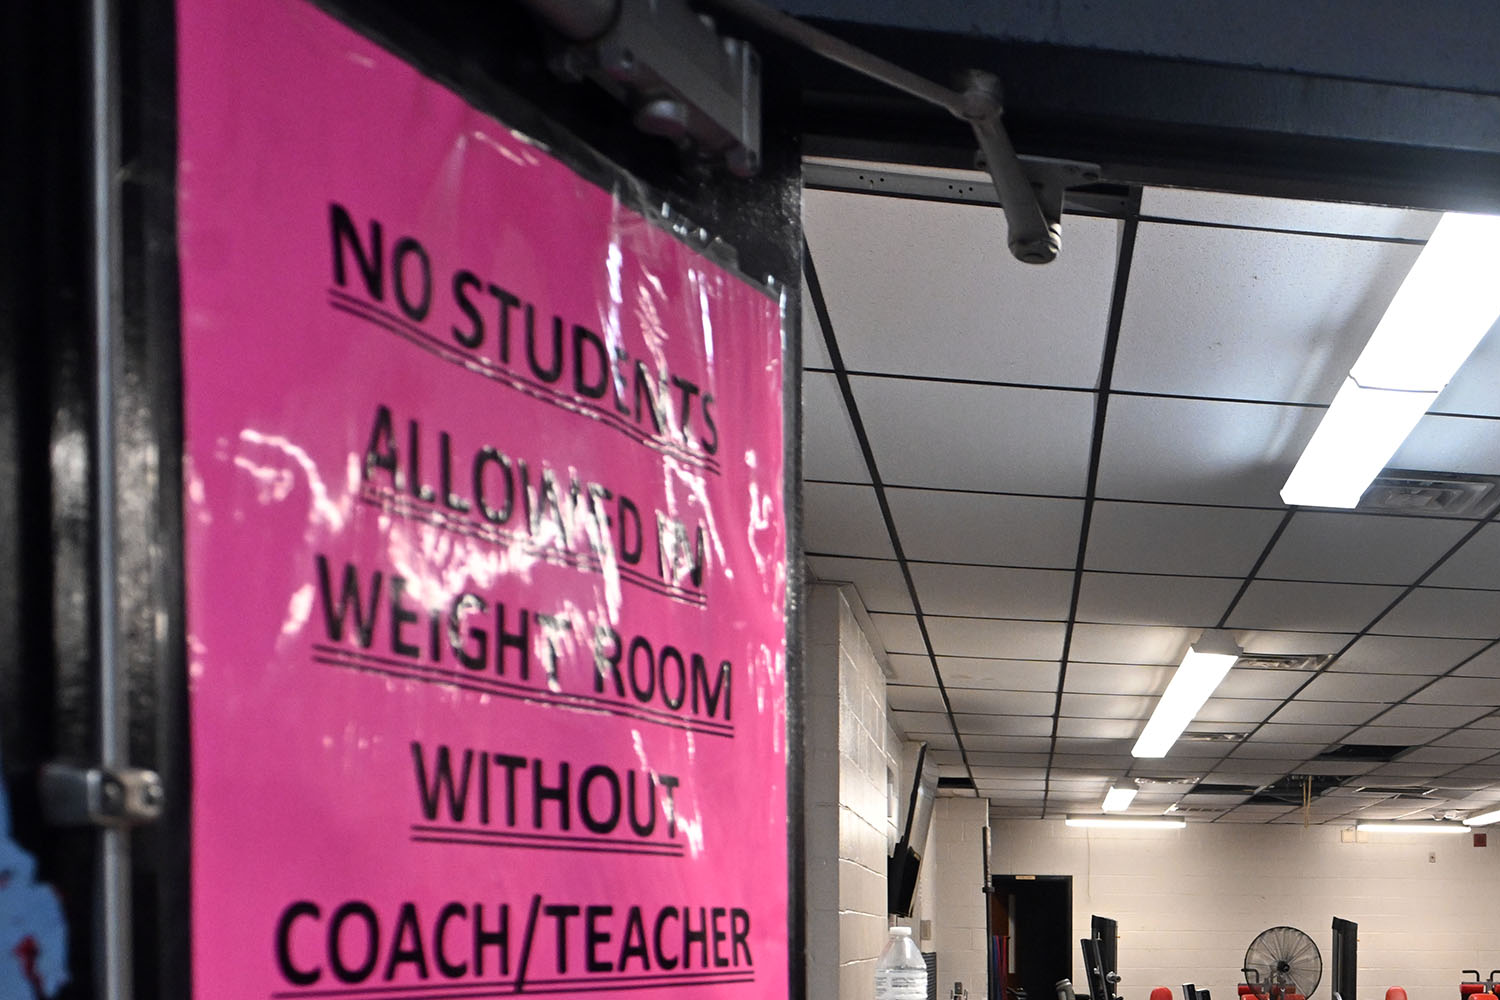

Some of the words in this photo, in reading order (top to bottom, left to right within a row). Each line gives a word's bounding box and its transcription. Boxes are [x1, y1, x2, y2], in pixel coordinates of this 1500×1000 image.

[329, 203, 433, 322] NO
[452, 270, 720, 455] STUDENTS
[362, 405, 643, 566] ALLOWED
[656, 508, 708, 589] IN
[316, 554, 573, 687] WEIGHT
[595, 628, 733, 721] ROOM
[412, 741, 682, 839] WITHOUT
[274, 894, 754, 993] COACH/TEACHER
